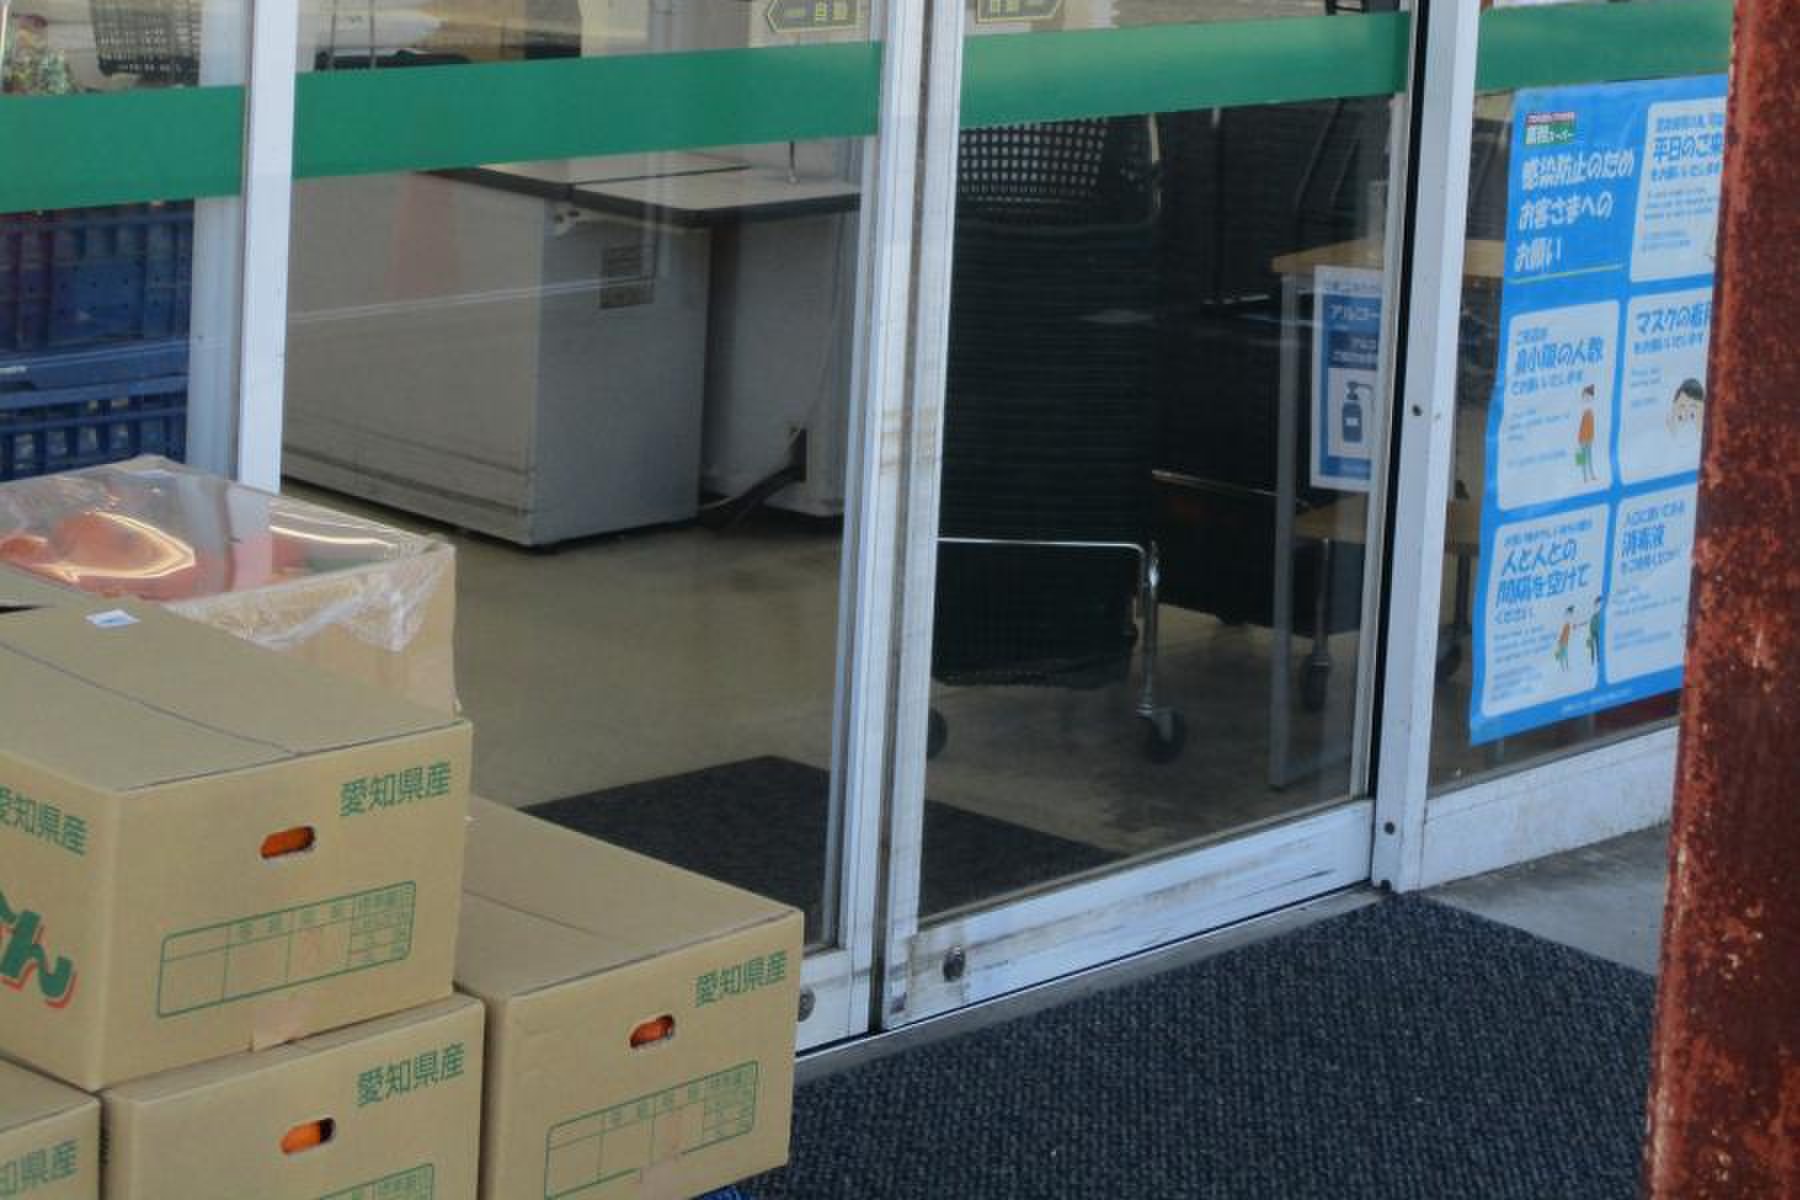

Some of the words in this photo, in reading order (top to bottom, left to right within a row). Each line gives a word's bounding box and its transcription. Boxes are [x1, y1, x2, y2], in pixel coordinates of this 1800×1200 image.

[1518, 191, 1615, 231] お客さまへの
[338, 760, 452, 818] 愛知県産
[695, 950, 788, 1008] 愛知県産
[357, 1042, 466, 1108] 愛知県産
